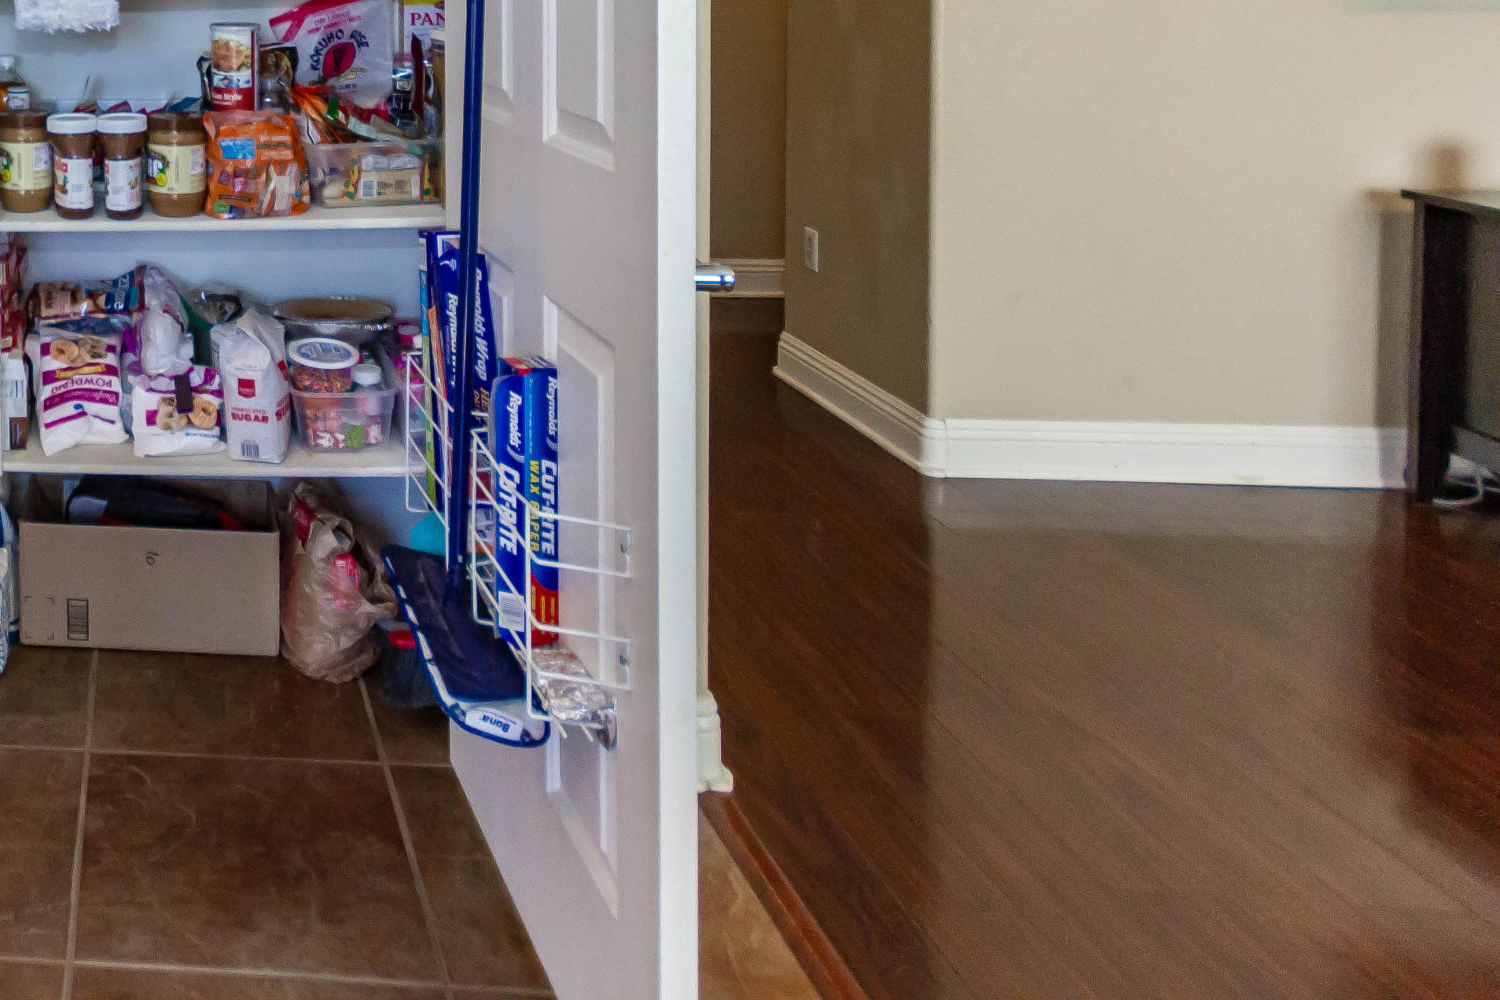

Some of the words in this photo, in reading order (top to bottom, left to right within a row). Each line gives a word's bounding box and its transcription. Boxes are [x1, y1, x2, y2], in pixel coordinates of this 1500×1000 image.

[309, 28, 345, 72] KOKUHO
[231, 412, 269, 424] SUGAR
[507, 390, 522, 447] Reynolds
[545, 375, 558, 437] Reynolds
[529, 460, 540, 495] WAX
[482, 714, 511, 734] Bona
